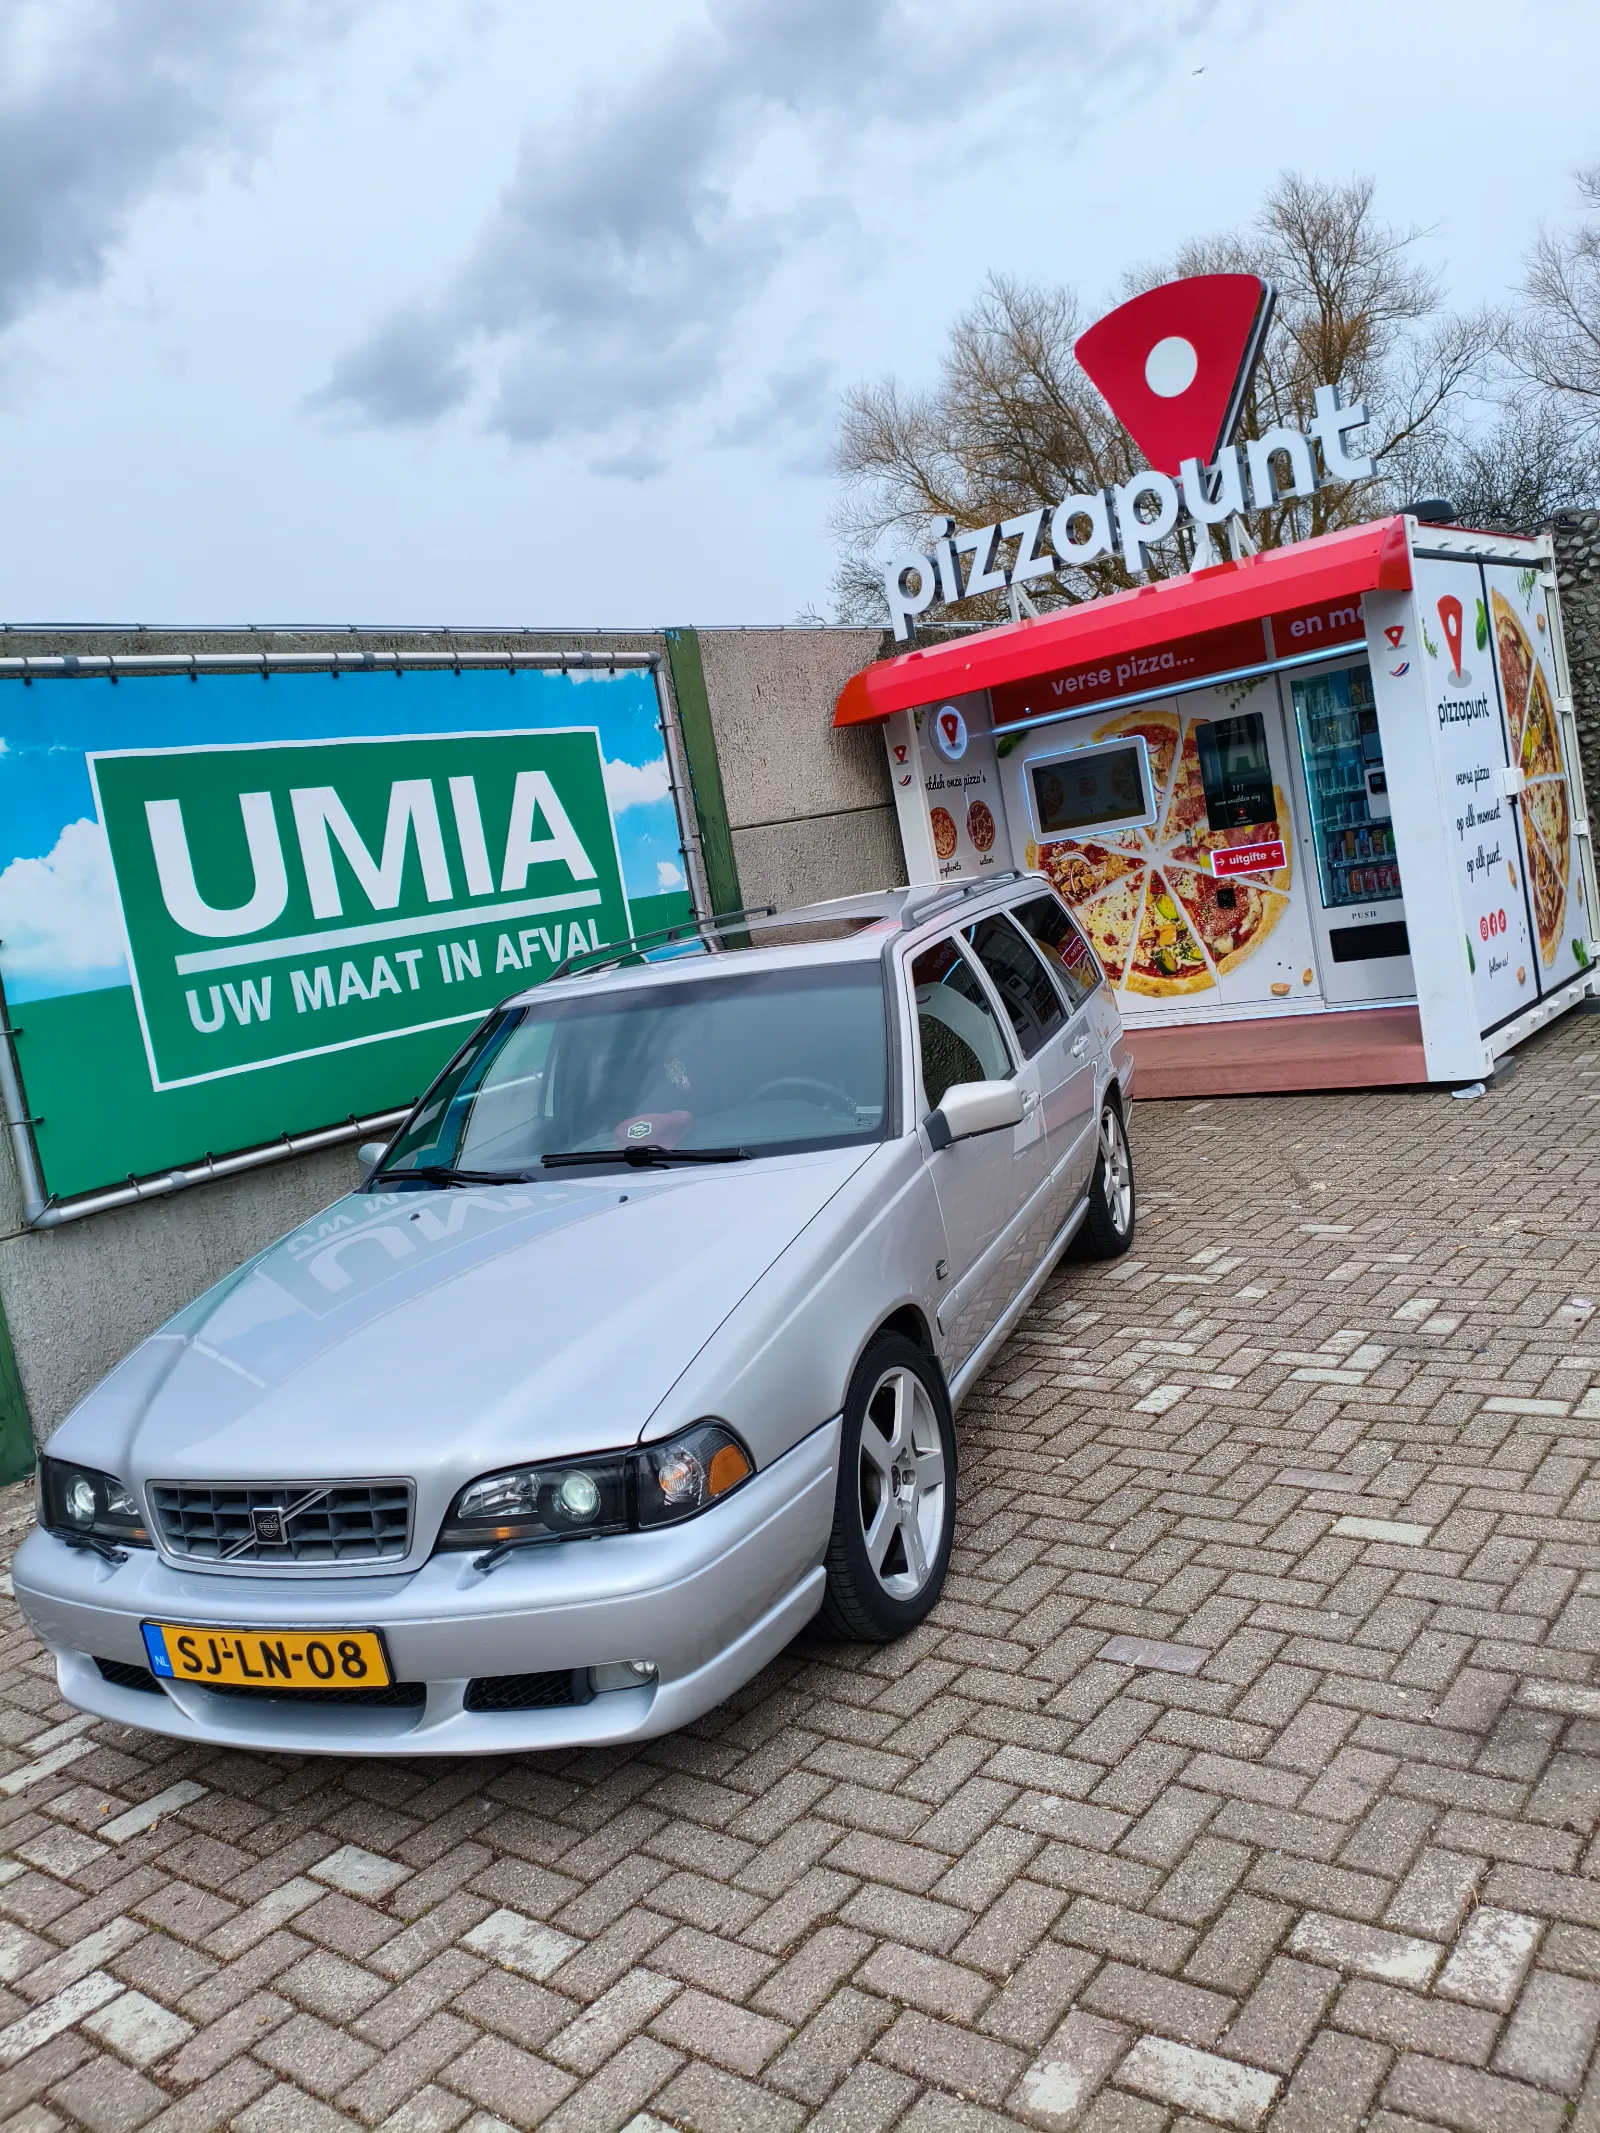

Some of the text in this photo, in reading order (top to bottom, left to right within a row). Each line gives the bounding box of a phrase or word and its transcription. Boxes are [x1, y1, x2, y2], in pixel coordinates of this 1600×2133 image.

[884, 385, 1377, 642] pizzapunt
[1290, 614, 1323, 637] en
[1051, 652, 1195, 696] verse pizza...
[1437, 692, 1490, 731] pizzapunt
[946, 778, 962, 788] onze
[963, 770, 987, 793] pizza's
[1455, 764, 1490, 793] verse pizza
[1456, 798, 1502, 841] op elk moment
[144, 770, 599, 938] UMIA
[1229, 853, 1267, 866] uitgifte
[1466, 860, 1474, 884] op
[1475, 845, 1486, 871] elk
[1351, 910, 1377, 920] PUSH
[185, 919, 611, 1033] UW MAAT IN AFVAL
[155, 1655, 170, 1668] NL
[177, 1635, 368, 1680] SJ-LN-08
